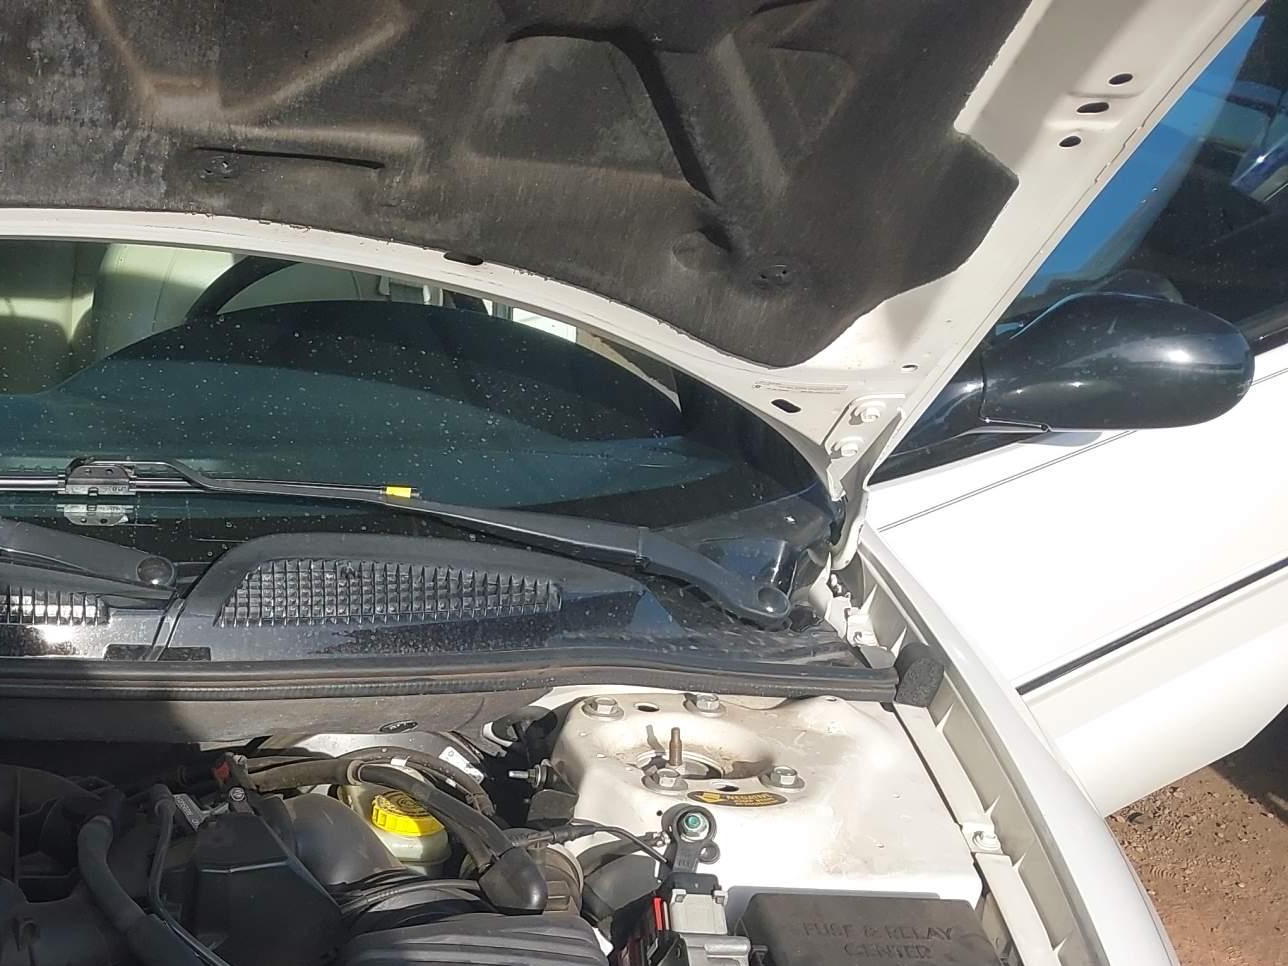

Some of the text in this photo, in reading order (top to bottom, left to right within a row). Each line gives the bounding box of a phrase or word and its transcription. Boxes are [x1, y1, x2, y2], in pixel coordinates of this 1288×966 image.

[802, 922, 853, 937] FUSE
[885, 925, 952, 940] RELAY
[844, 943, 932, 959] CENTER
